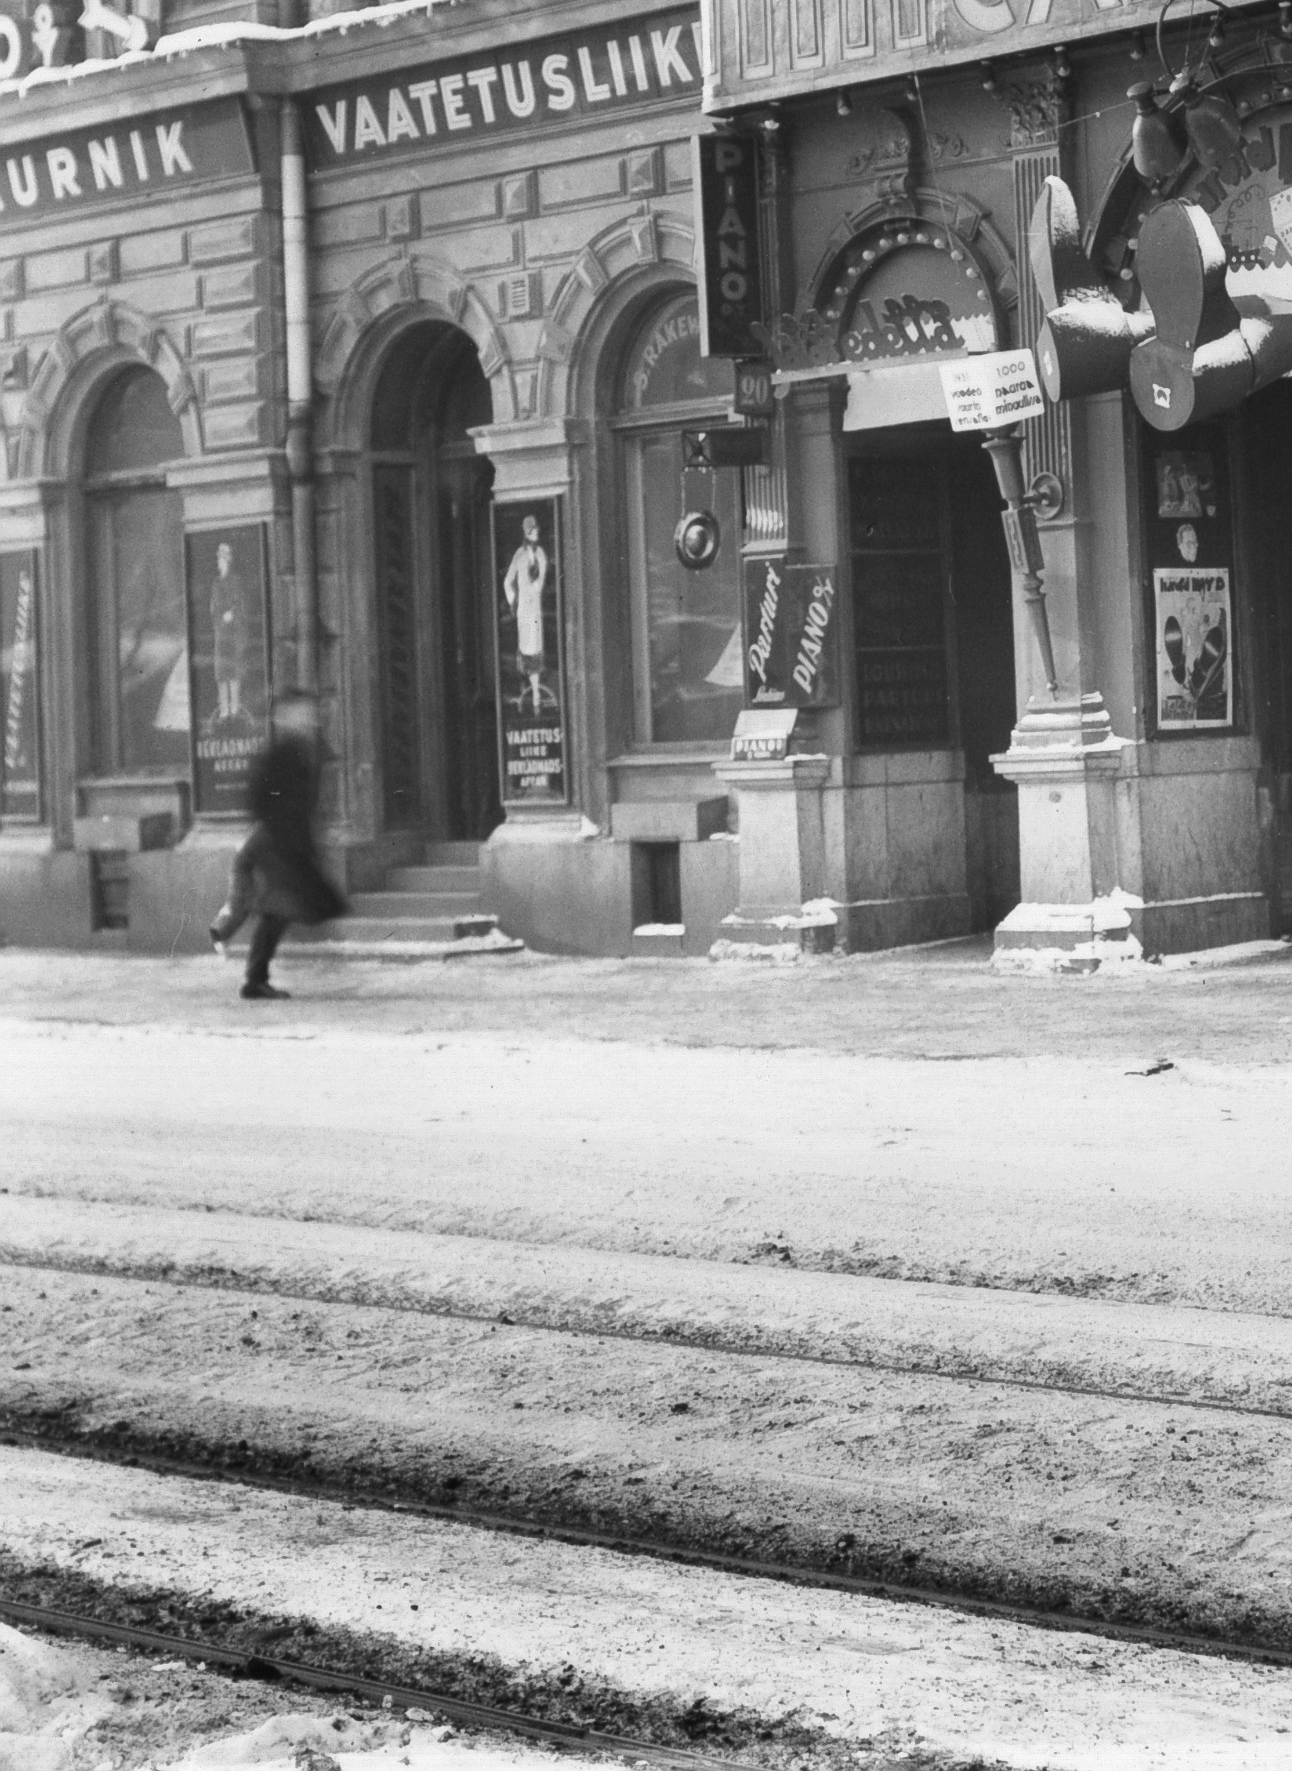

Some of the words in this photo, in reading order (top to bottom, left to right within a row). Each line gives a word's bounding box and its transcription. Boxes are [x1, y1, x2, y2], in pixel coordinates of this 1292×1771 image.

[315, 20, 702, 155] VAATETUSLIIK
[0, 120, 194, 211] URNIK
[714, 142, 748, 302] PIANO
[996, 360, 1026, 379] 1000
[792, 601, 829, 694] PIANO
